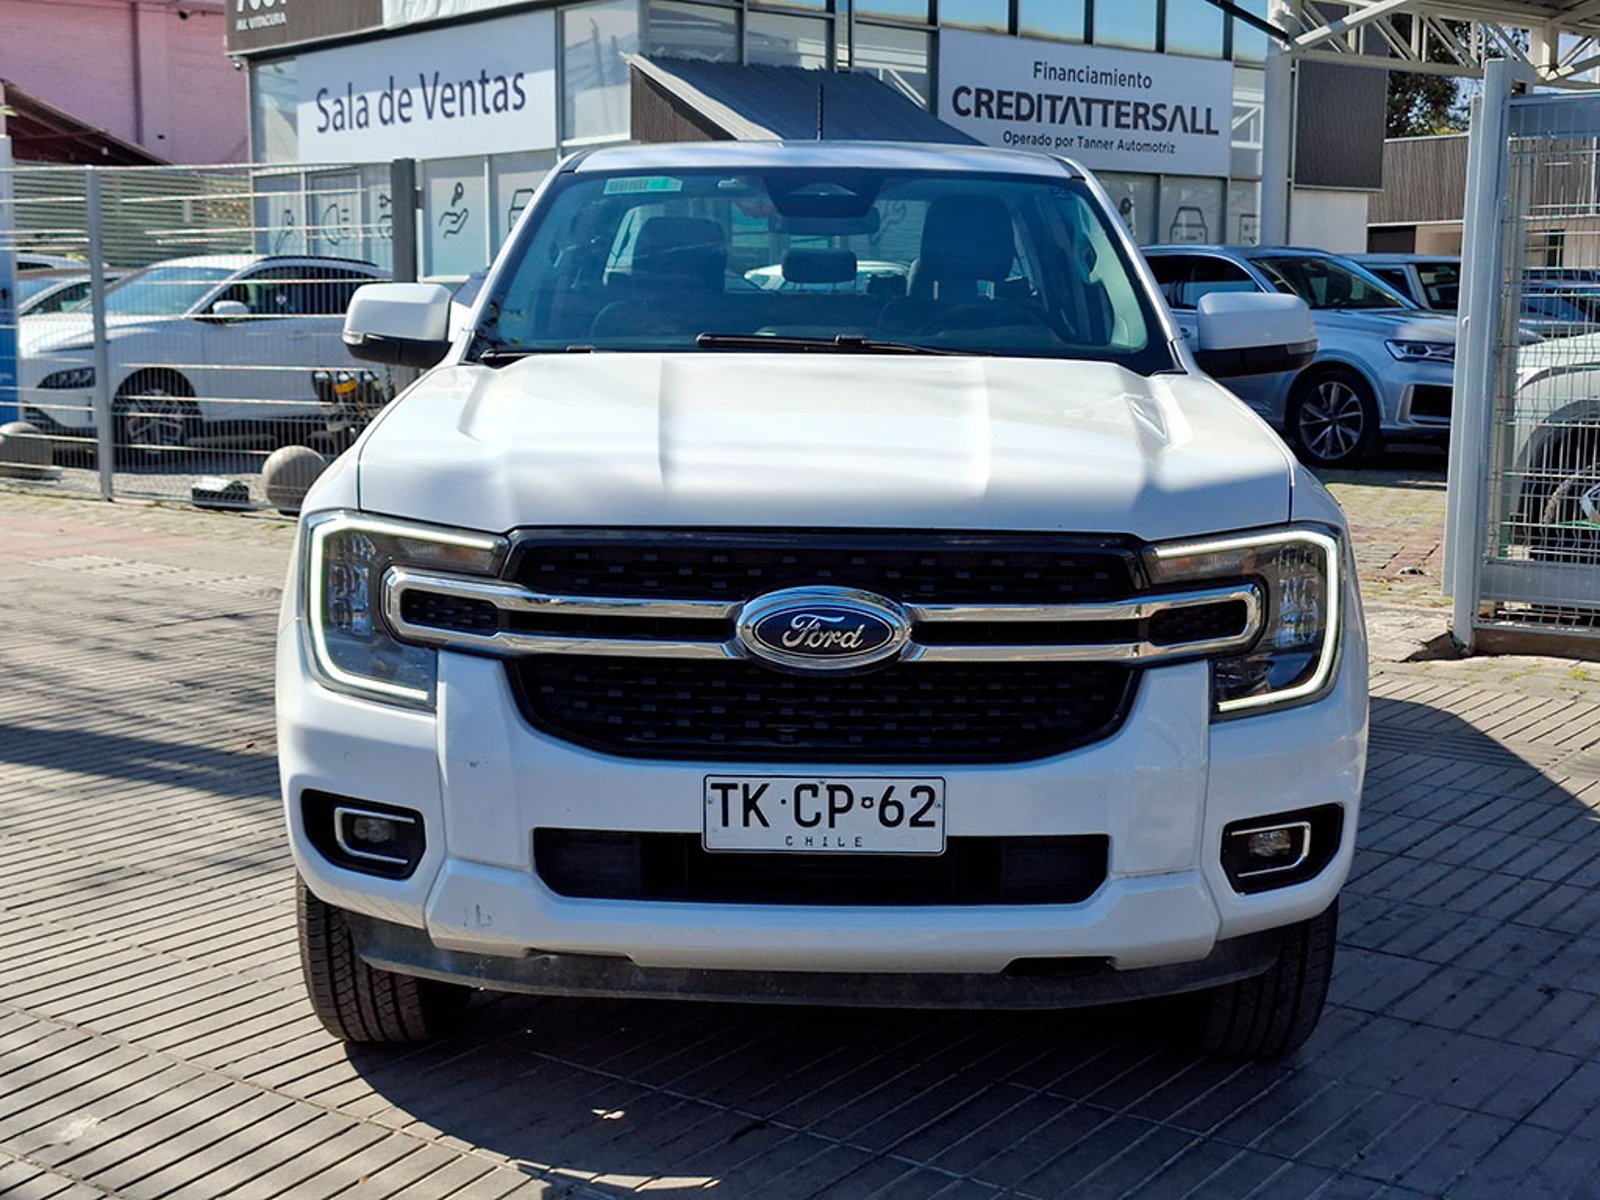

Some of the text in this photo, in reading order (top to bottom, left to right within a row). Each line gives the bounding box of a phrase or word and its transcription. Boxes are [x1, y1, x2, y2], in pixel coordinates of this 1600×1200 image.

[1033, 61, 1152, 88] Financiamiento
[316, 68, 526, 133] Sala de Ventas
[952, 85, 1219, 136] CREDITATTERSALL
[1002, 130, 1176, 154] Operado por Tanner Automotriz
[782, 613, 865, 648] Ford
[785, 835, 863, 848] CHILE
